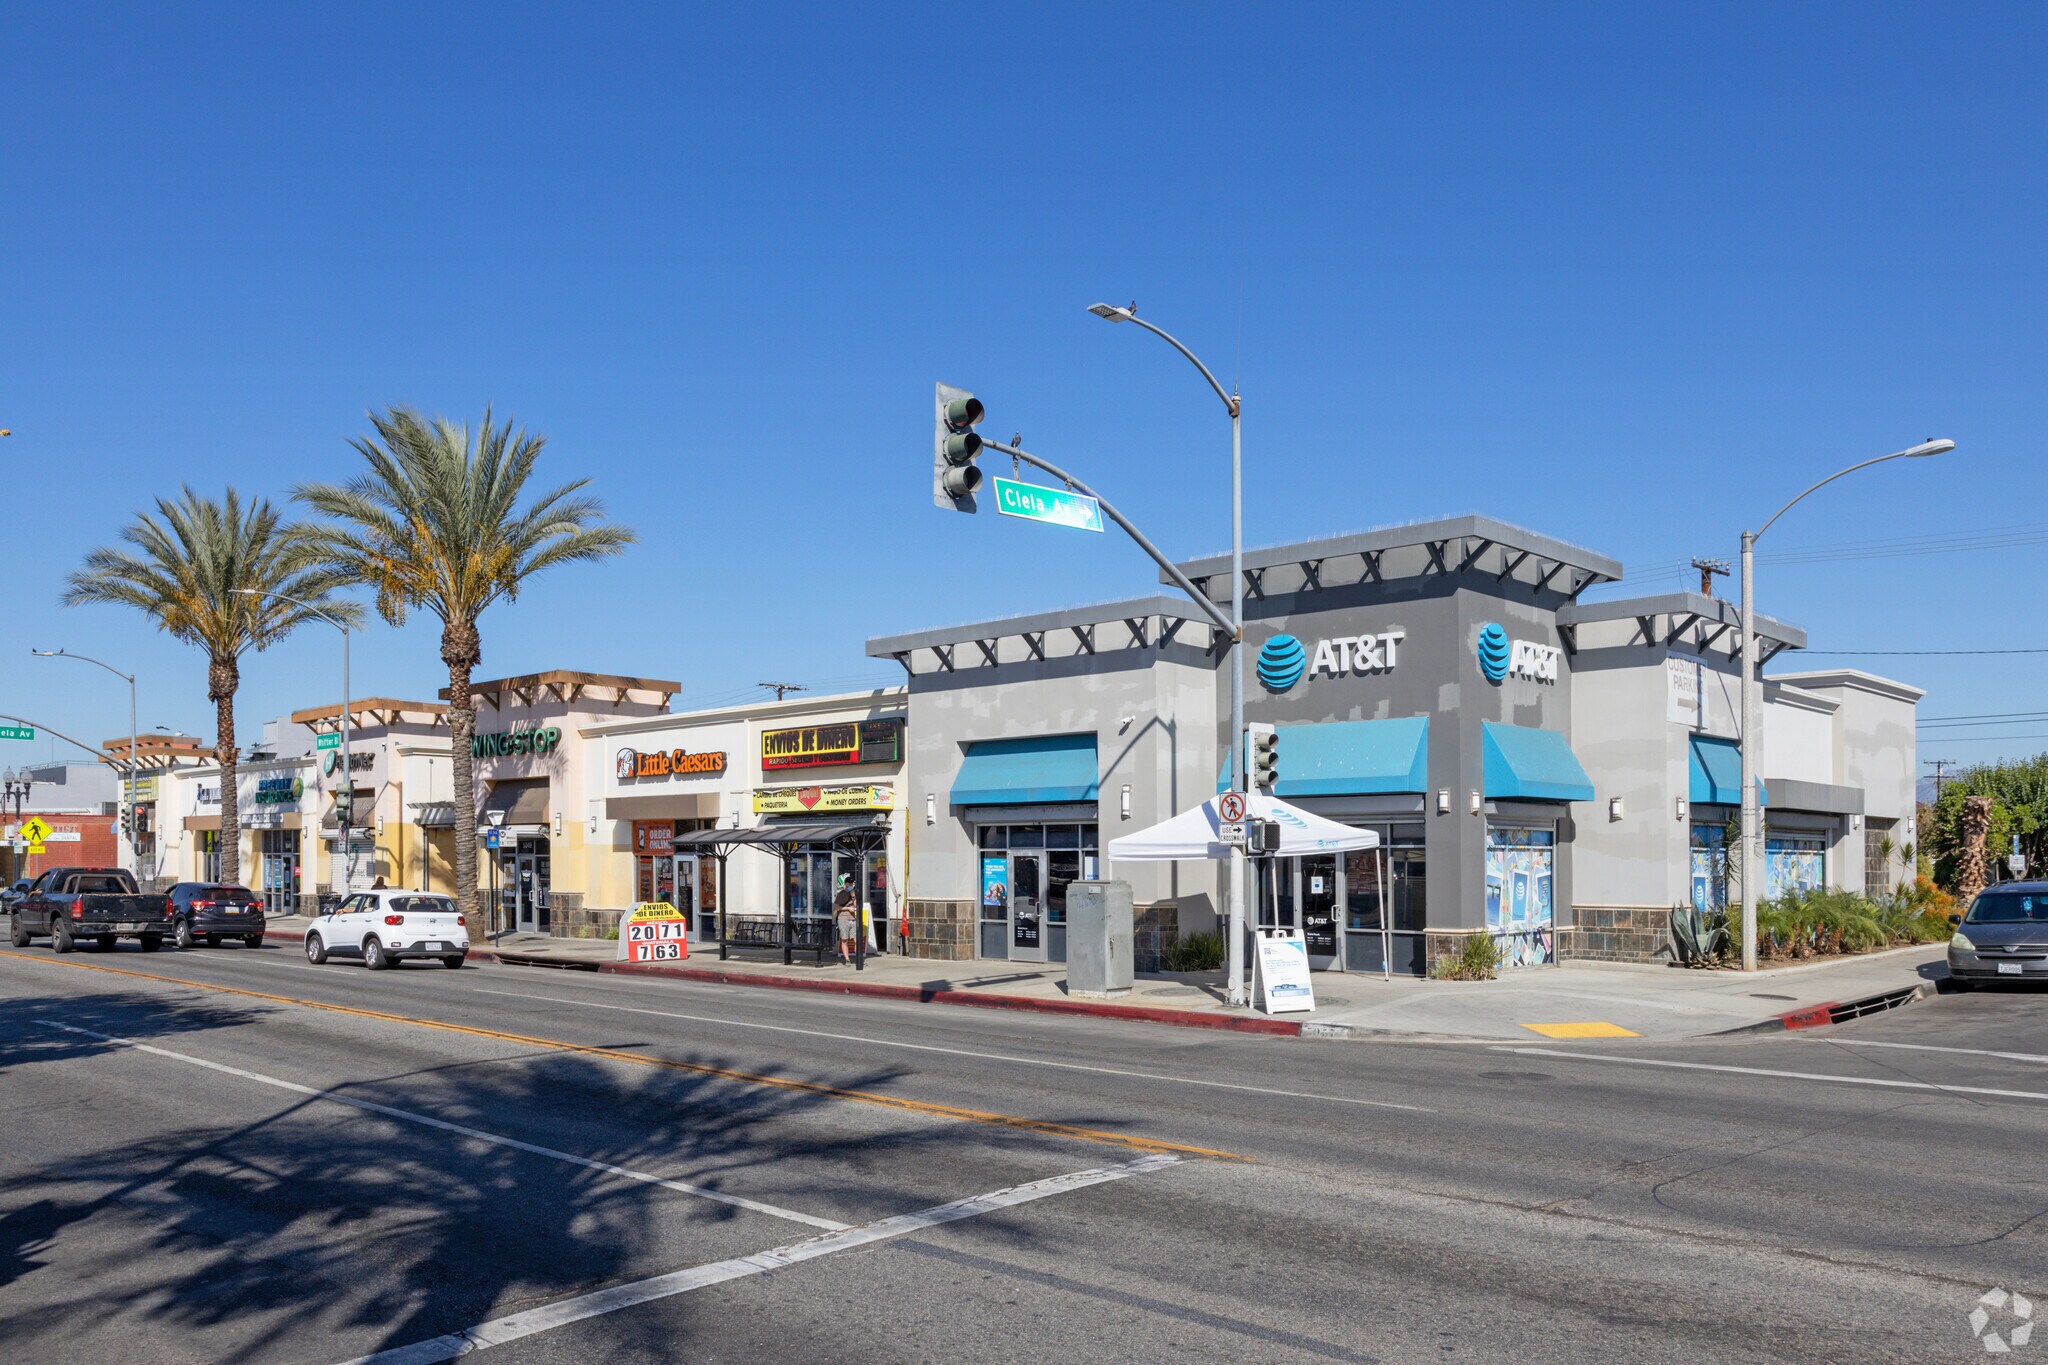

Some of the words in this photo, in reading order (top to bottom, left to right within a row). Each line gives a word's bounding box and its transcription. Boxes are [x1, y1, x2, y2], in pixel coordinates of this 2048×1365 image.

[1005, 488, 1045, 511] Clela
[1309, 631, 1405, 676] AT&T
[1509, 639, 1562, 680] AT&T
[19, 730, 31, 738] Av
[764, 731, 799, 755] ENVIOS
[801, 729, 815, 752] DE
[816, 725, 855, 751] DINERO
[636, 750, 670, 776] Little
[672, 748, 723, 774] Caesars
[259, 778, 293, 791] FREEWAY
[255, 790, 296, 804] INSURANCE
[830, 798, 847, 806] MONEY
[848, 797, 867, 805] ORDERS
[649, 829, 671, 839] ORDER
[1222, 826, 1232, 834] USE
[1221, 834, 1245, 842] CROSSWALK
[631, 924, 681, 940] 20.71
[640, 945, 678, 960] 7.63
